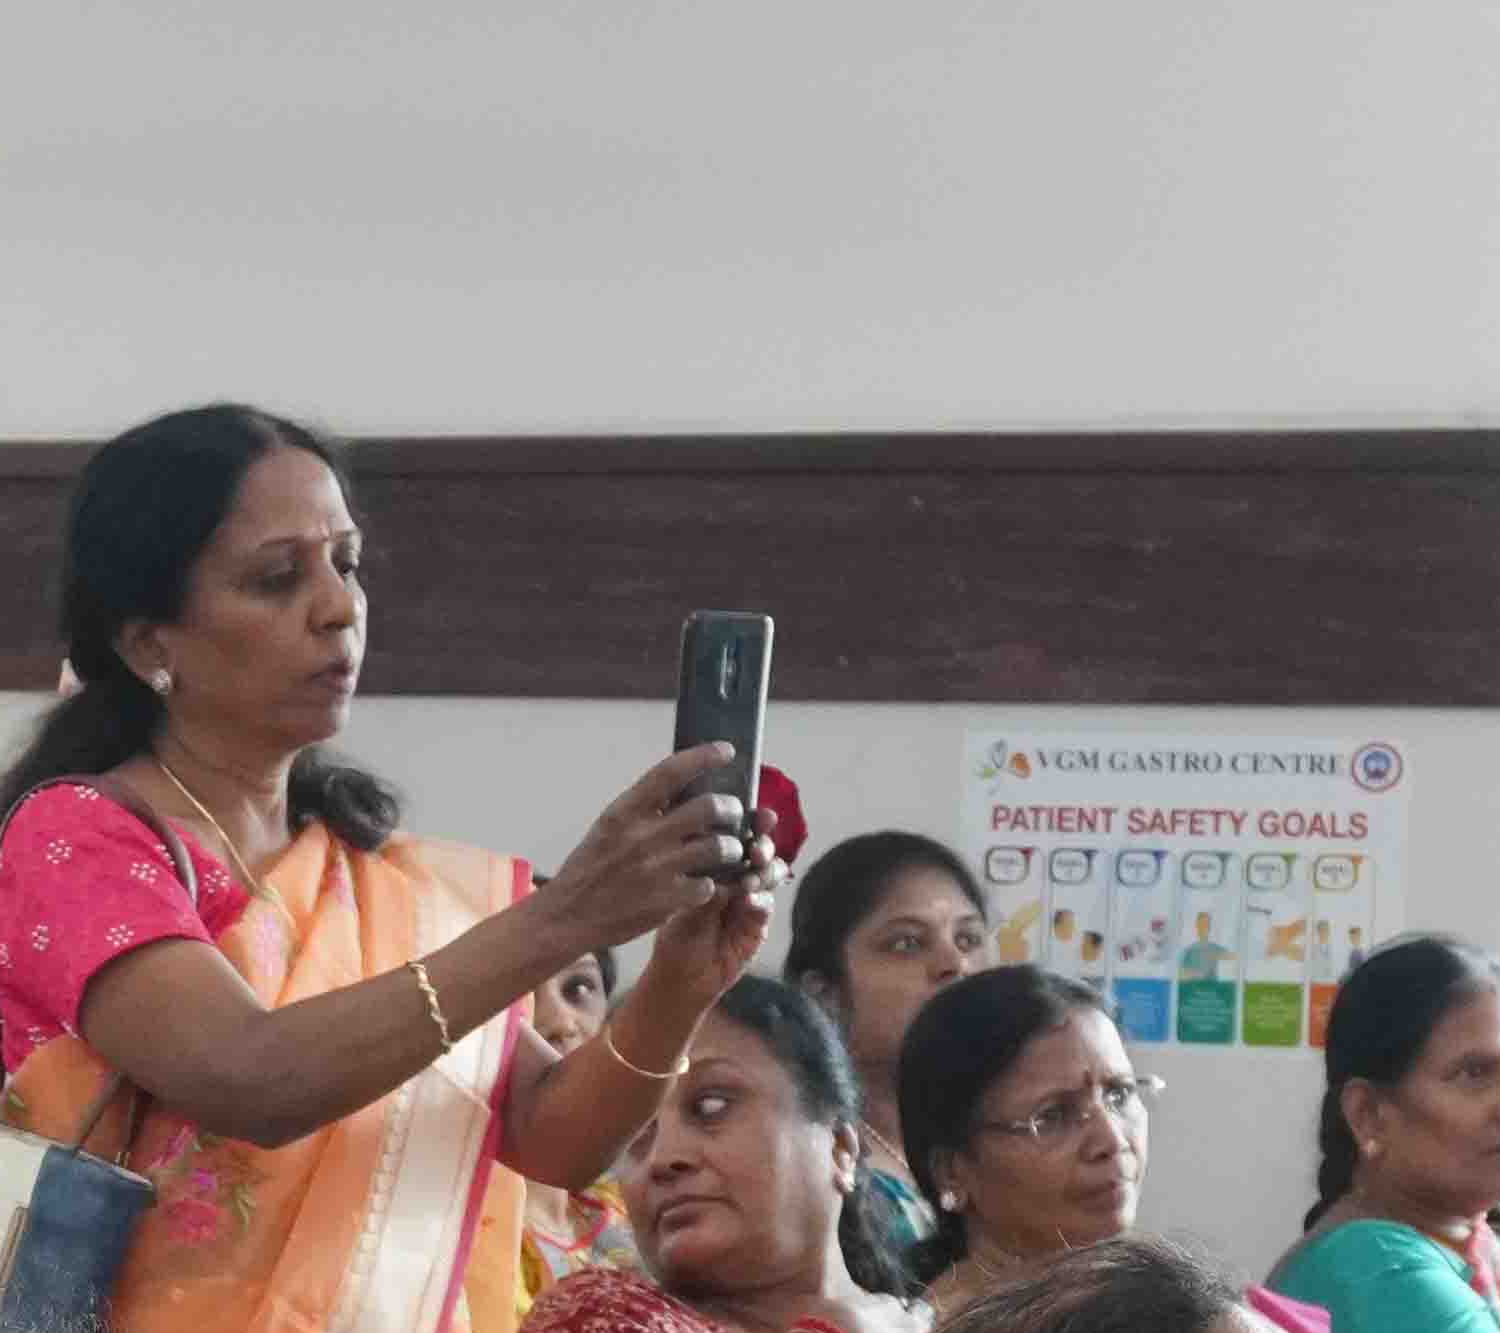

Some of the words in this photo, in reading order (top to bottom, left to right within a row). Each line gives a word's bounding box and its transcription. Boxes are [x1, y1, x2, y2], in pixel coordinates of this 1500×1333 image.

[1036, 748, 1099, 770] VGM
[1108, 750, 1222, 773] GASTRO
[1231, 753, 1344, 776] CENTRE
[991, 804, 1117, 834] PATIENT
[1127, 807, 1248, 838] SAFETY
[1257, 811, 1370, 841] GOALS
